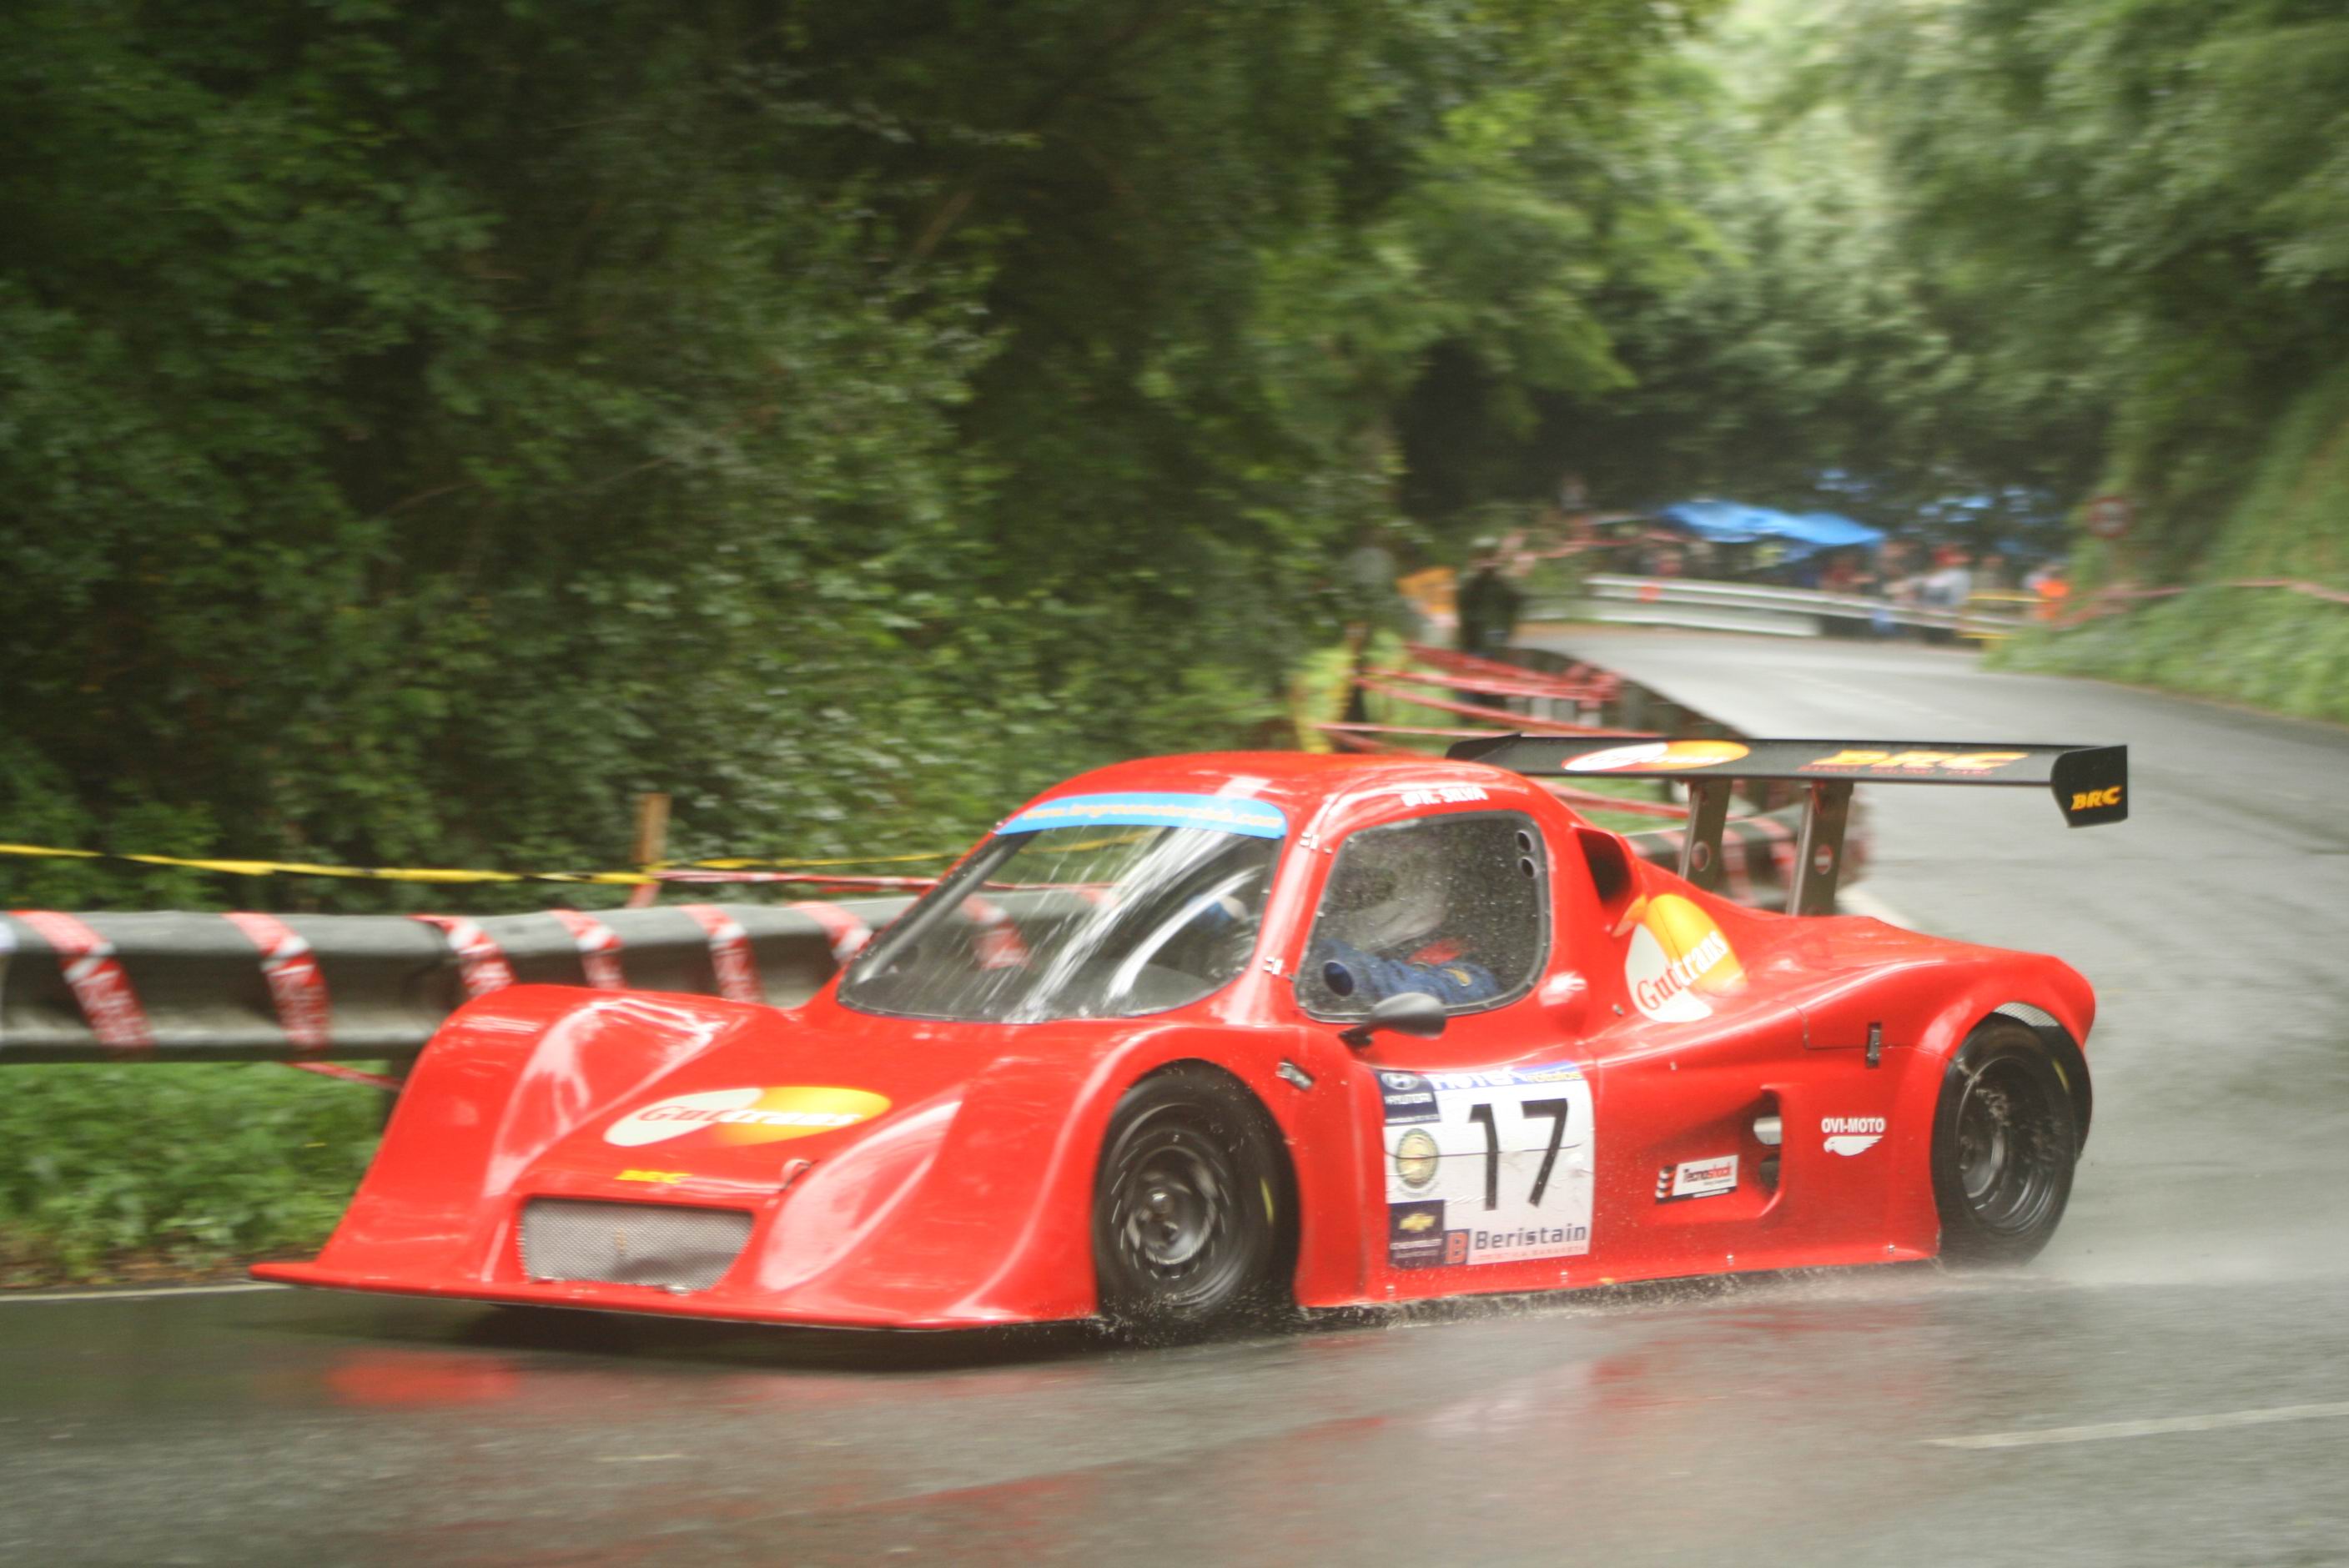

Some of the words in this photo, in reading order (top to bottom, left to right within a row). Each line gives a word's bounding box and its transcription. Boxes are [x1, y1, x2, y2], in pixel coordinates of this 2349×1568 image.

[2070, 785, 2122, 811] BRC
[1637, 930, 1728, 1011] Guttrans
[636, 1105, 863, 1127] Guttrans
[1821, 1117, 1885, 1133] OVI-MOTO
[1468, 1098, 1568, 1211] 17
[1475, 1224, 1587, 1250] Beristain
